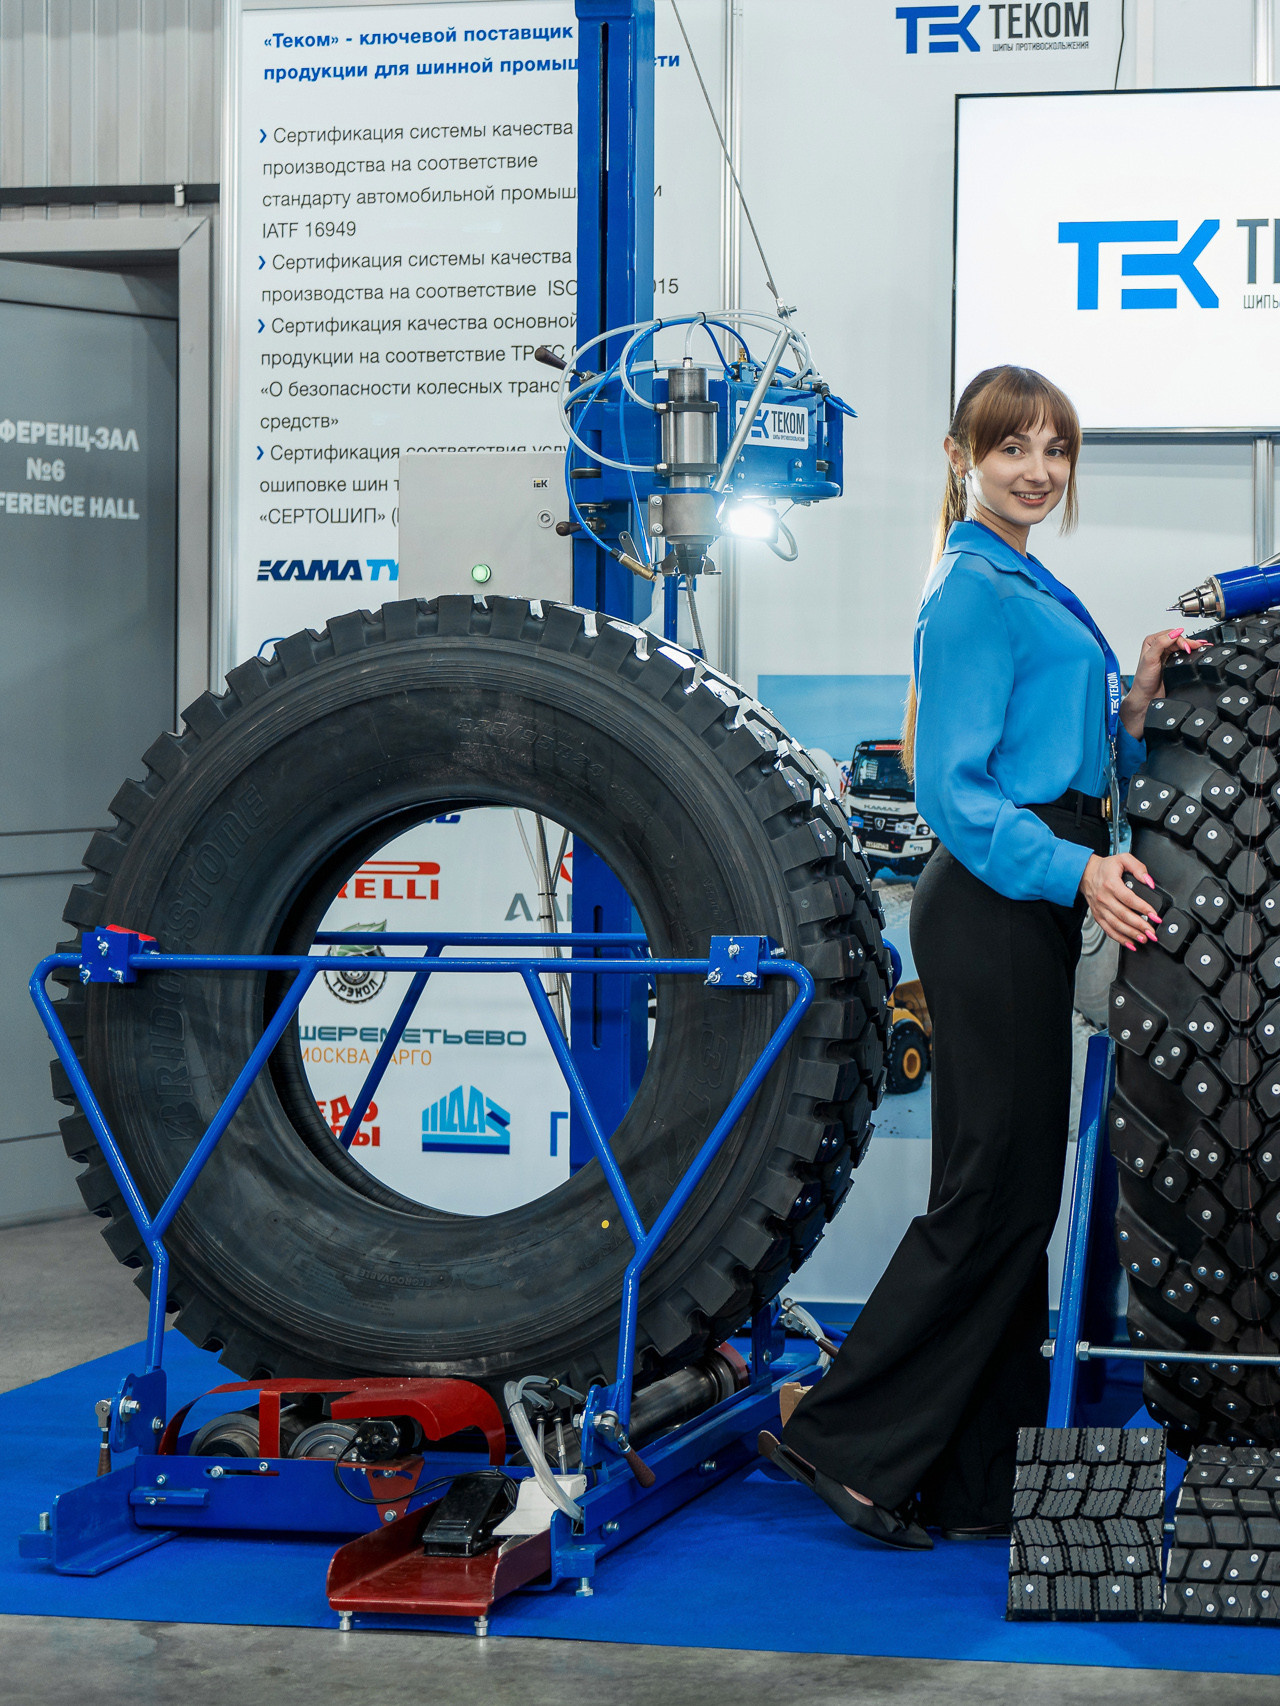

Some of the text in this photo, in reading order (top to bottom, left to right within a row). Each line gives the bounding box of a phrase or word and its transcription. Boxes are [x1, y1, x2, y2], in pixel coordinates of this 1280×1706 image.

[988, 1, 1089, 39] ТЕКОМ
[265, 27, 573, 48] «Теком» ключевой поставщик
[993, 41, 1089, 52] ШИПЫ ПРОТИВОСКОЛЬЖЕНИЯ
[264, 65, 367, 83] продукции
[375, 64, 408, 80] для
[417, 57, 492, 76] шинной
[274, 123, 573, 147] Сертификация системы качества
[264, 156, 537, 179] производства на соответствие
[263, 193, 351, 209] стандарту
[357, 185, 494, 205] автомобильной
[263, 221, 356, 238] IATF 16949
[273, 252, 571, 273] Сертификация системы качества
[262, 287, 383, 305] производства
[390, 287, 410, 299] на
[416, 284, 536, 298] соответствие
[272, 312, 576, 337] Сертификация качества основной
[262, 345, 535, 369] продукции на соответствие ТР
[261, 380, 502, 397] «О безопасности колесных
[261, 417, 338, 432] средств»
[771, 410, 805, 435] ТЕКОМ
[271, 444, 399, 464] Сертификация
[26, 457, 66, 482] №6
[260, 480, 387, 492] ошиповке шин
[89, 497, 140, 520] HALL
[260, 508, 385, 524] «СЕРТОШИП»
[257, 559, 363, 581] KAMA
[1107, 672, 1119, 697] ТЕКОМ
[863, 803, 901, 812] KAMAZ
[376, 1049, 432, 1065] АРГО
